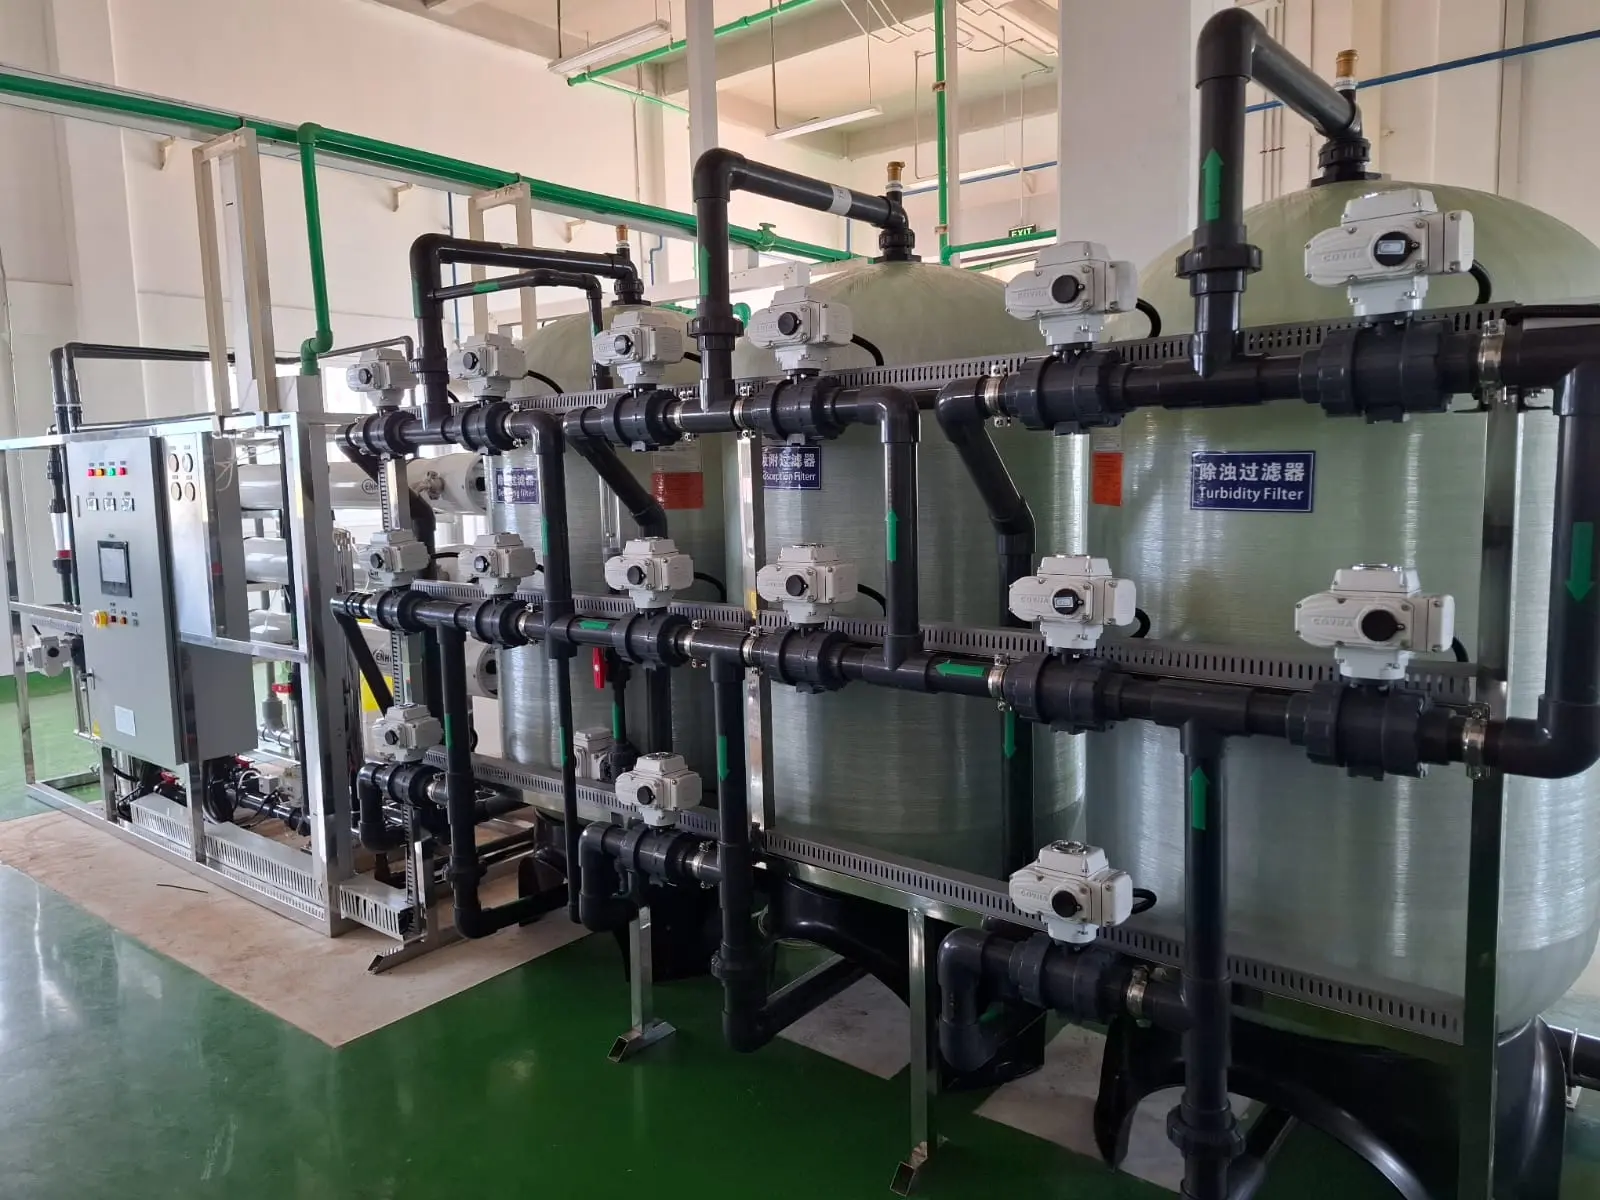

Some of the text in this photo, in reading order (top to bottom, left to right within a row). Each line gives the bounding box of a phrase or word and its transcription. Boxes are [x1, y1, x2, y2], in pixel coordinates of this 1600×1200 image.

[1011, 227, 1033, 238] EXIT
[1199, 462, 1305, 482] 除浊过滤器
[1199, 486, 1304, 503] Turbidity Filter
